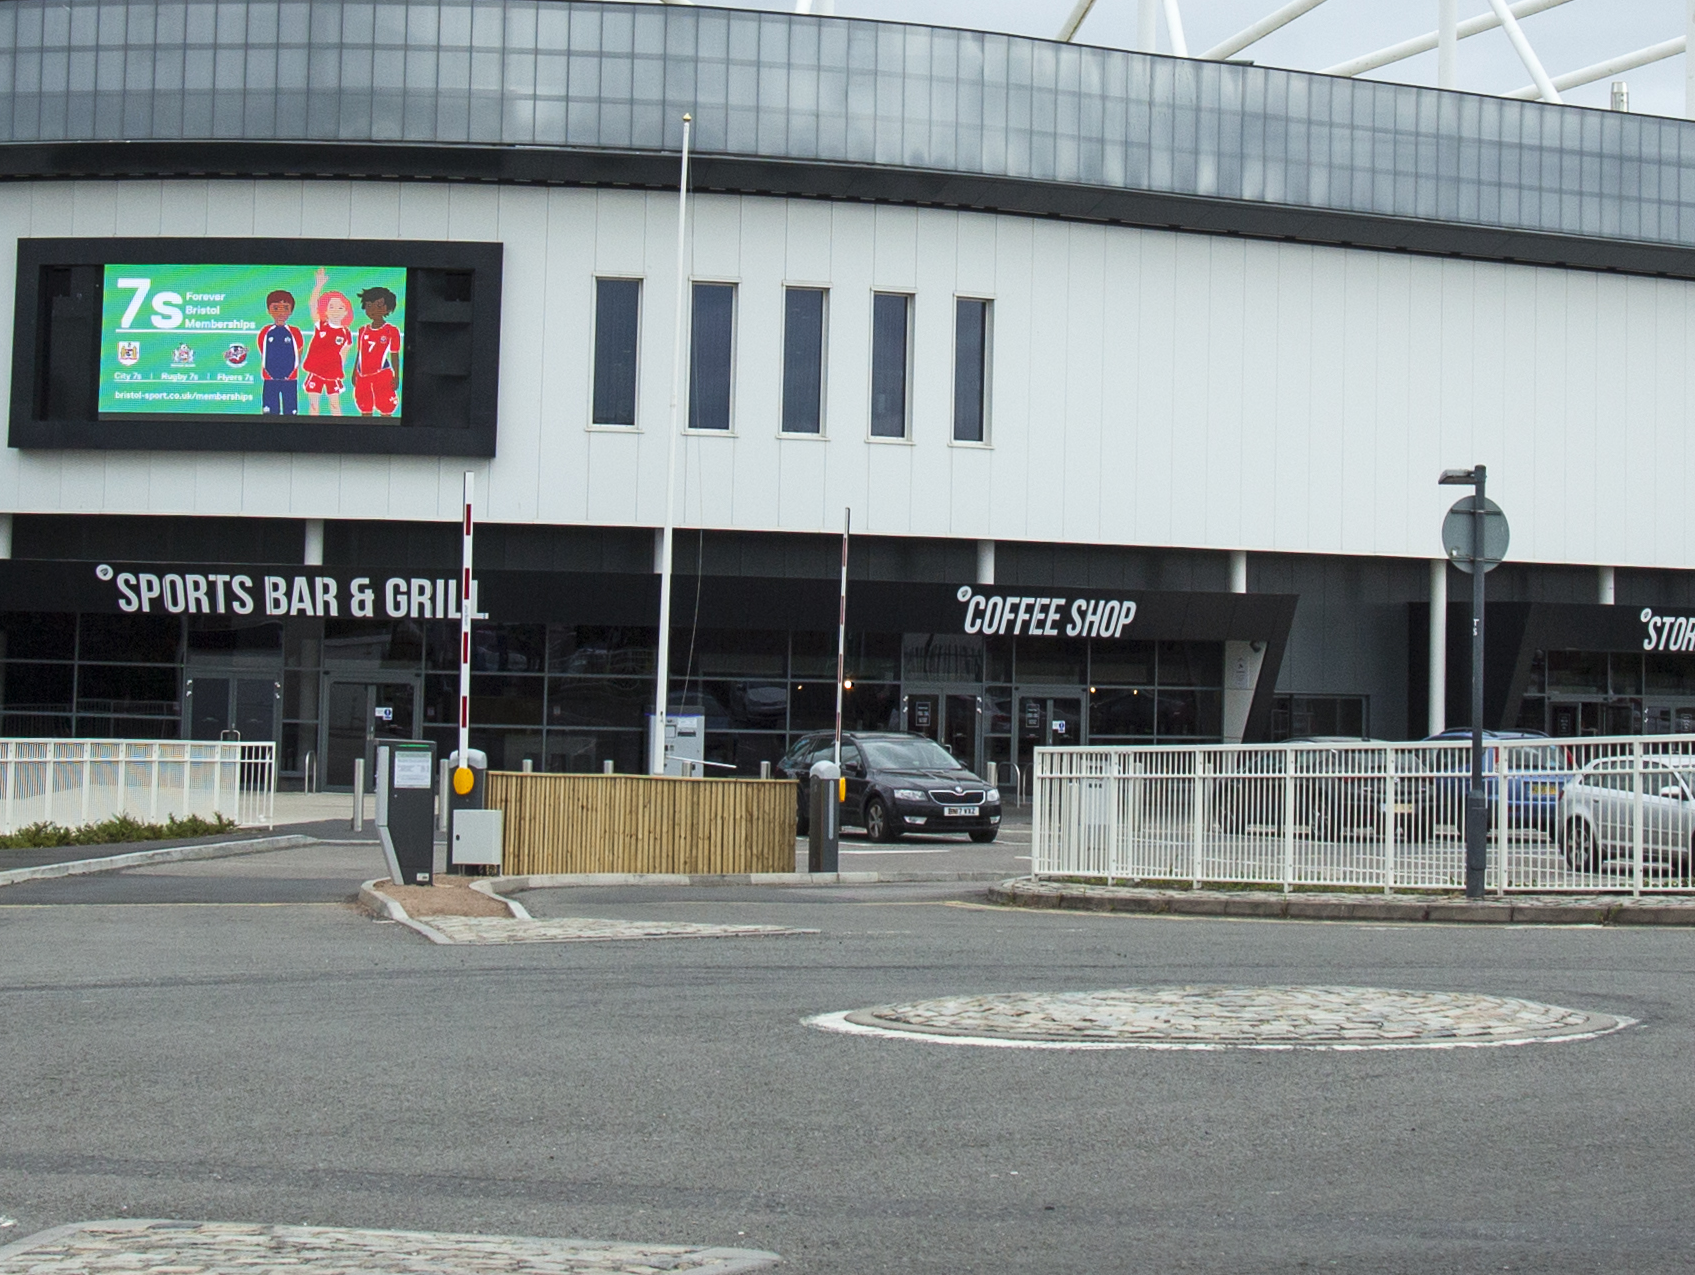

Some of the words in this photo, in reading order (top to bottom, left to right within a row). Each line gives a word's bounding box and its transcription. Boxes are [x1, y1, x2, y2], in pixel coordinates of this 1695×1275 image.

[186, 292, 226, 302] Forever
[116, 278, 183, 329] 7s
[185, 306, 220, 315] Bristol
[184, 319, 256, 329] Memberships
[114, 372, 132, 381] City
[133, 372, 142, 380] 7s
[161, 373, 187, 382] Rugby
[189, 373, 199, 381] 7s
[217, 373, 243, 382] Flyers
[244, 374, 254, 382] 7s
[114, 390, 254, 402] bristol-sport.co.uk/memberships
[116, 572, 255, 616] SPORTS
[264, 575, 339, 617] BAR
[350, 577, 375, 618] &
[385, 577, 490, 620] GRILL
[963, 594, 1067, 636] COFFEE
[1066, 598, 1137, 638] SHOP
